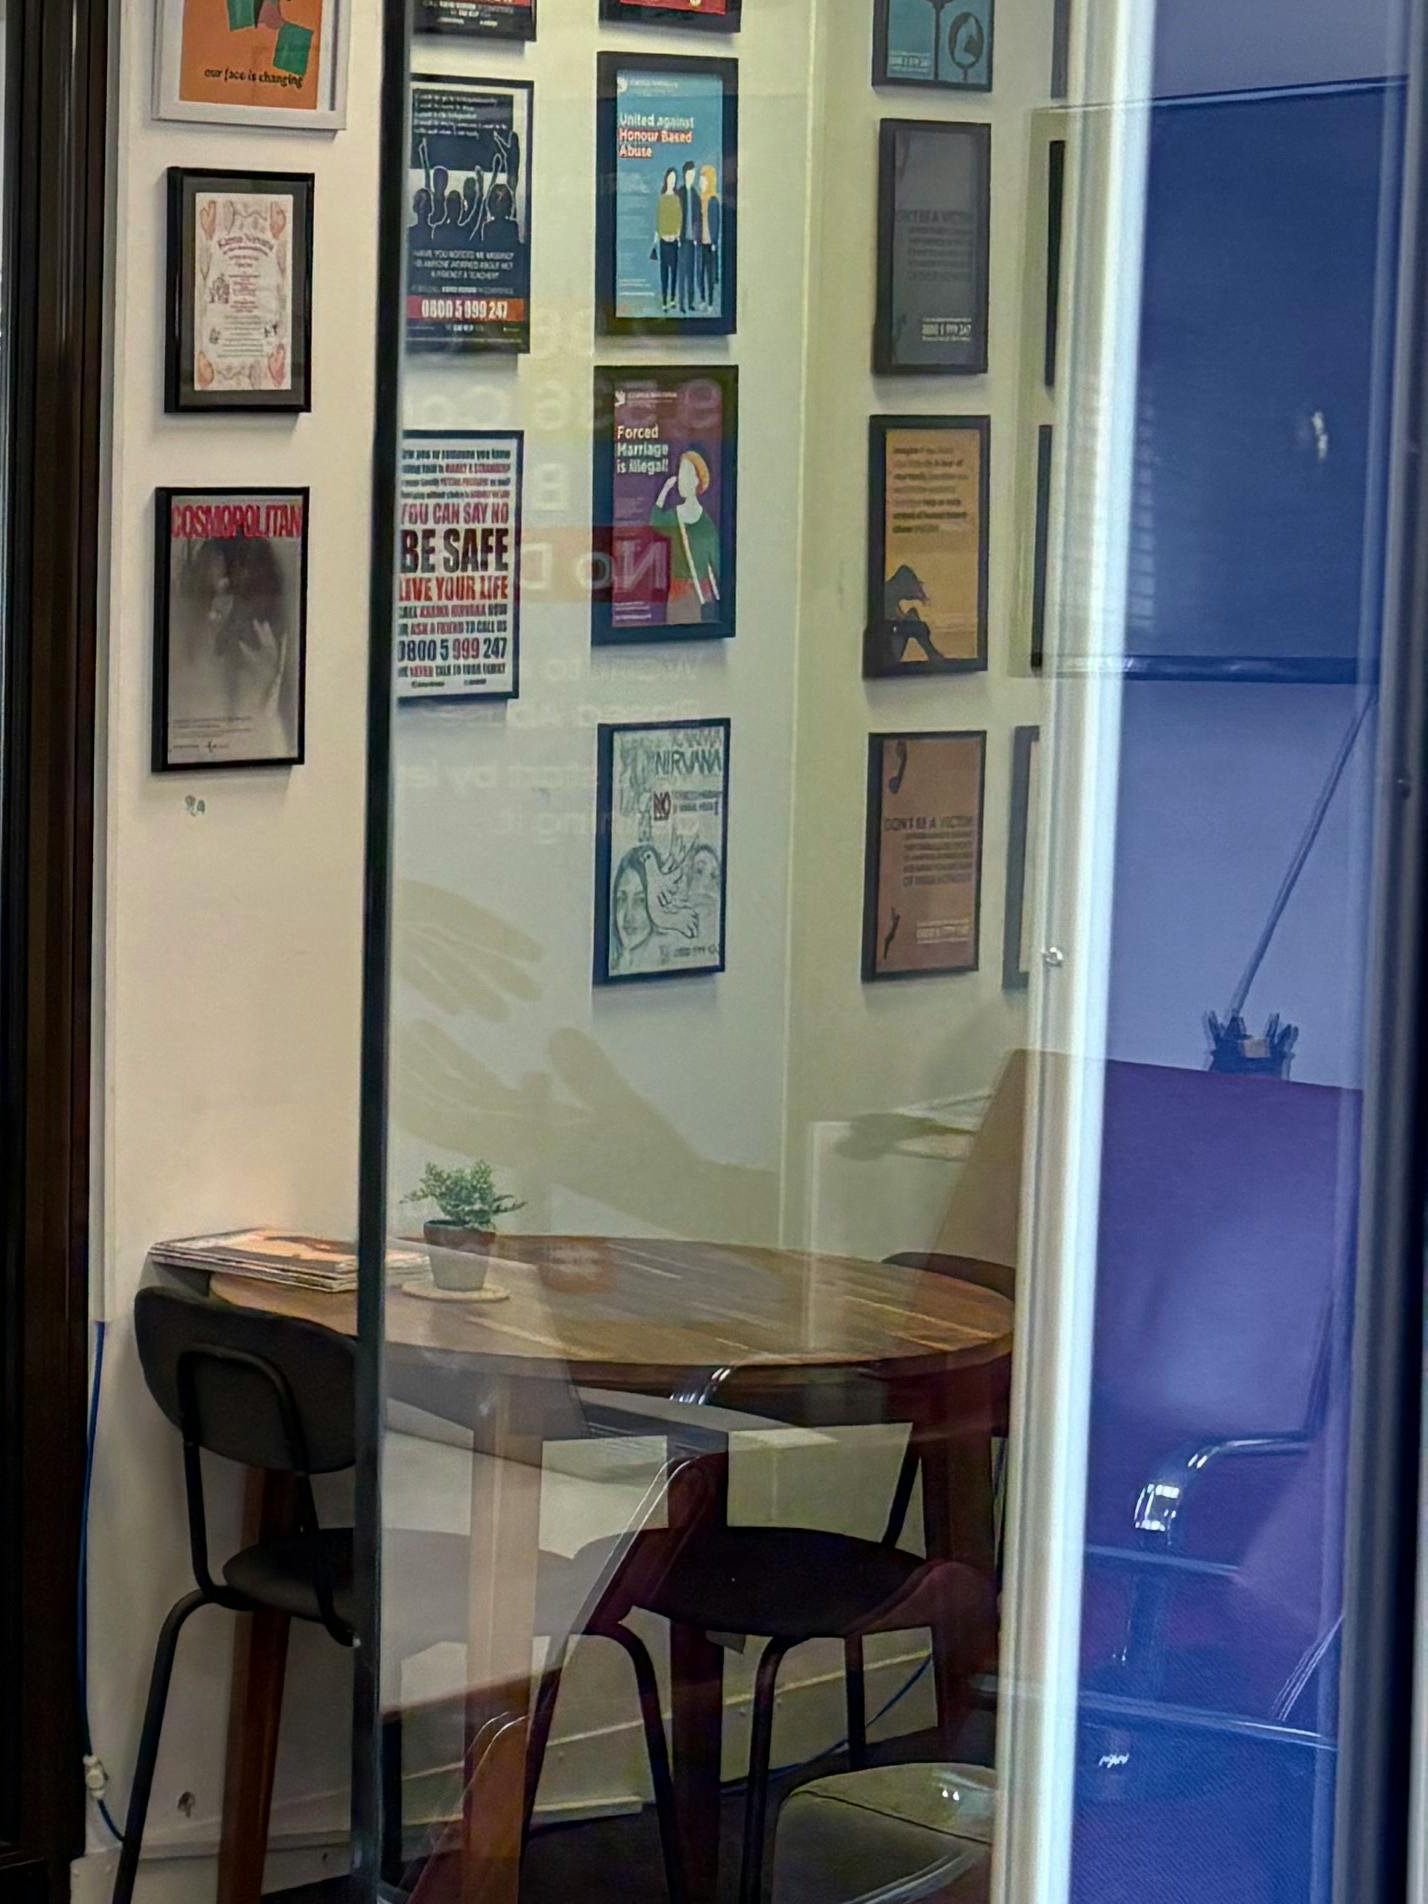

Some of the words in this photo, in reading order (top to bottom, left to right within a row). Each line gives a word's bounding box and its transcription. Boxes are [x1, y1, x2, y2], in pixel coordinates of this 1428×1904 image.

[205, 69, 222, 78] our
[248, 69, 256, 81] is
[258, 71, 304, 89] changing
[620, 112, 655, 127] United
[656, 116, 694, 130] against
[619, 128, 659, 142] Honour
[660, 130, 693, 144] Based
[619, 144, 652, 158] Abuse
[421, 299, 453, 318] 0800
[455, 299, 463, 319] 5
[488, 300, 508, 319] 247
[617, 423, 659, 439] Forced
[617, 441, 669, 458] Marriage
[617, 458, 626, 474] is
[170, 504, 302, 540] COSMOPOLITAN
[433, 502, 460, 525] CAN
[464, 502, 489, 525] SAY
[491, 502, 509, 524] NO
[400, 528, 436, 574] BE
[442, 528, 509, 573] SAFE
[399, 576, 433, 601] LIVE
[435, 575, 476, 601] YOUR
[479, 574, 508, 600] LIFE
[440, 638, 449, 661] 5
[452, 637, 480, 661] 999
[482, 636, 507, 659] 247
